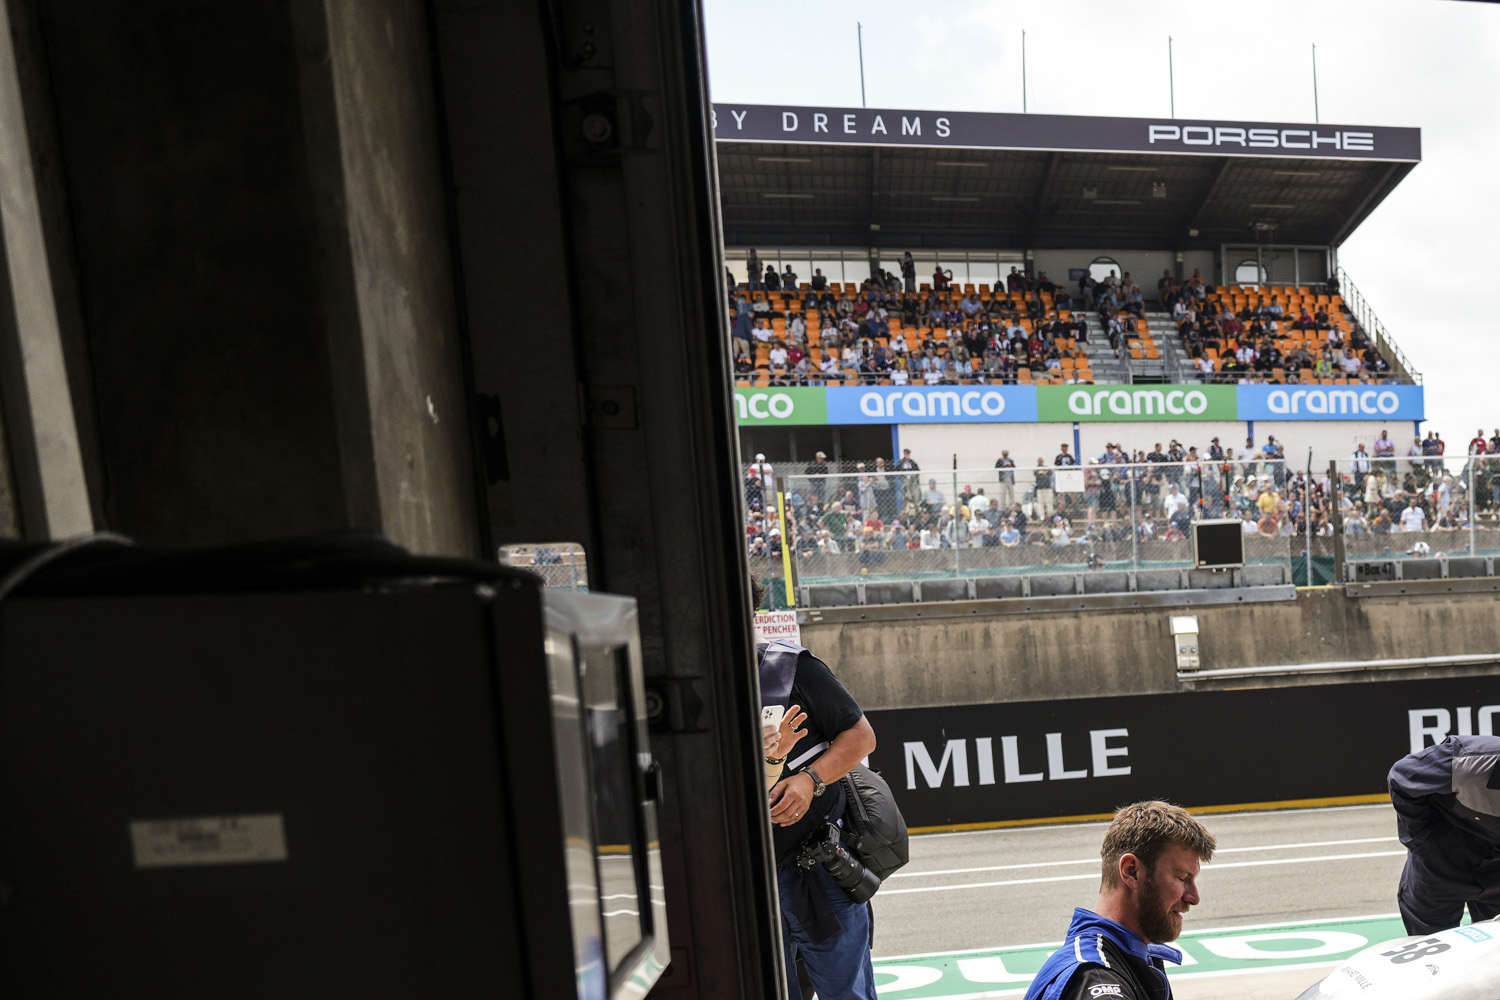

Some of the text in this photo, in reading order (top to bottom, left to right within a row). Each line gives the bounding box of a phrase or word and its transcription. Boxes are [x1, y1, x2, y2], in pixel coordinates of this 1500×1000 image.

[782, 112, 950, 138] DREAMS
[1149, 125, 1374, 151] PORSCHE
[860, 391, 1005, 417] aramco
[1068, 390, 1207, 415] aramco
[1267, 390, 1399, 415] aramco
[1364, 562, 1392, 576] Box 47
[763, 625, 797, 634] PENCHER
[903, 728, 1132, 790] MILLE
[1380, 938, 1451, 964] 58
[1090, 986, 1121, 996] OMP
